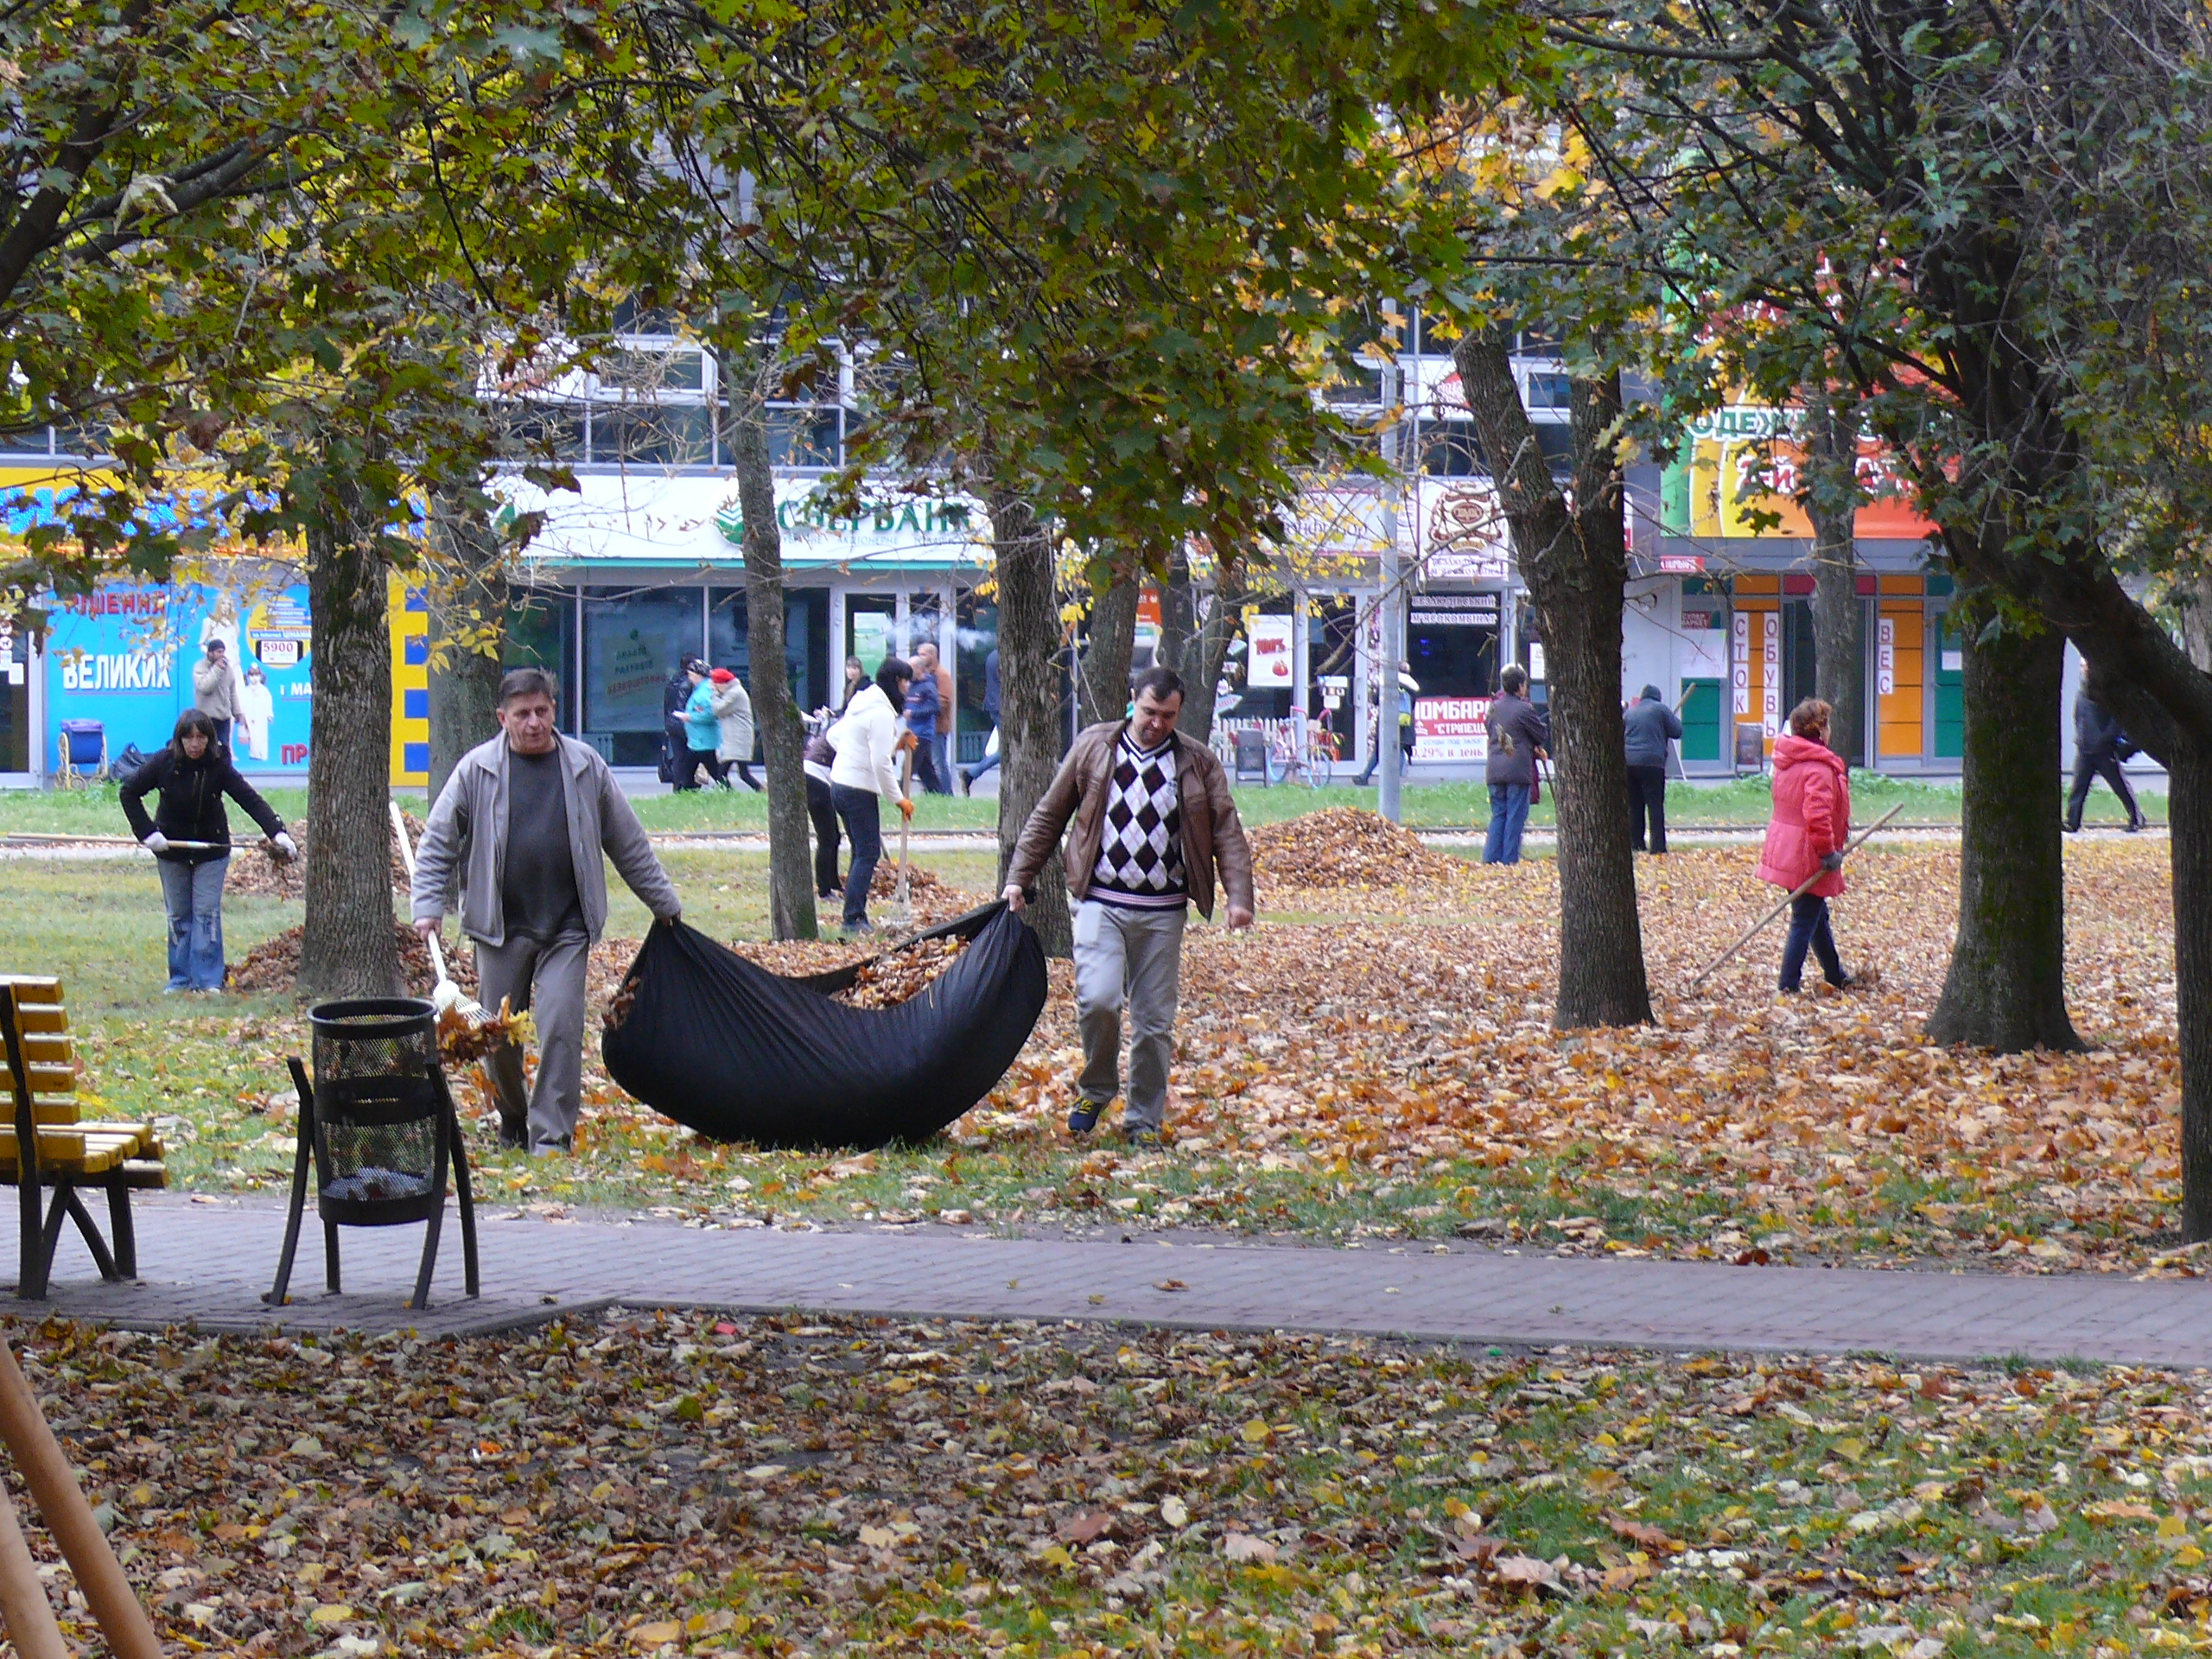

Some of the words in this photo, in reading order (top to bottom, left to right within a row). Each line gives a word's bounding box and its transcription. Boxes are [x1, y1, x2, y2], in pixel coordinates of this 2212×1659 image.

[777, 499, 976, 532] СБРБАН
[63, 653, 171, 690] ВЕЛИКИХ
[263, 642, 294, 653] 5900
[1735, 619, 1746, 715] СТОК
[1880, 625, 1890, 693] ВЕС
[1765, 619, 1777, 738] ОБУВЬ
